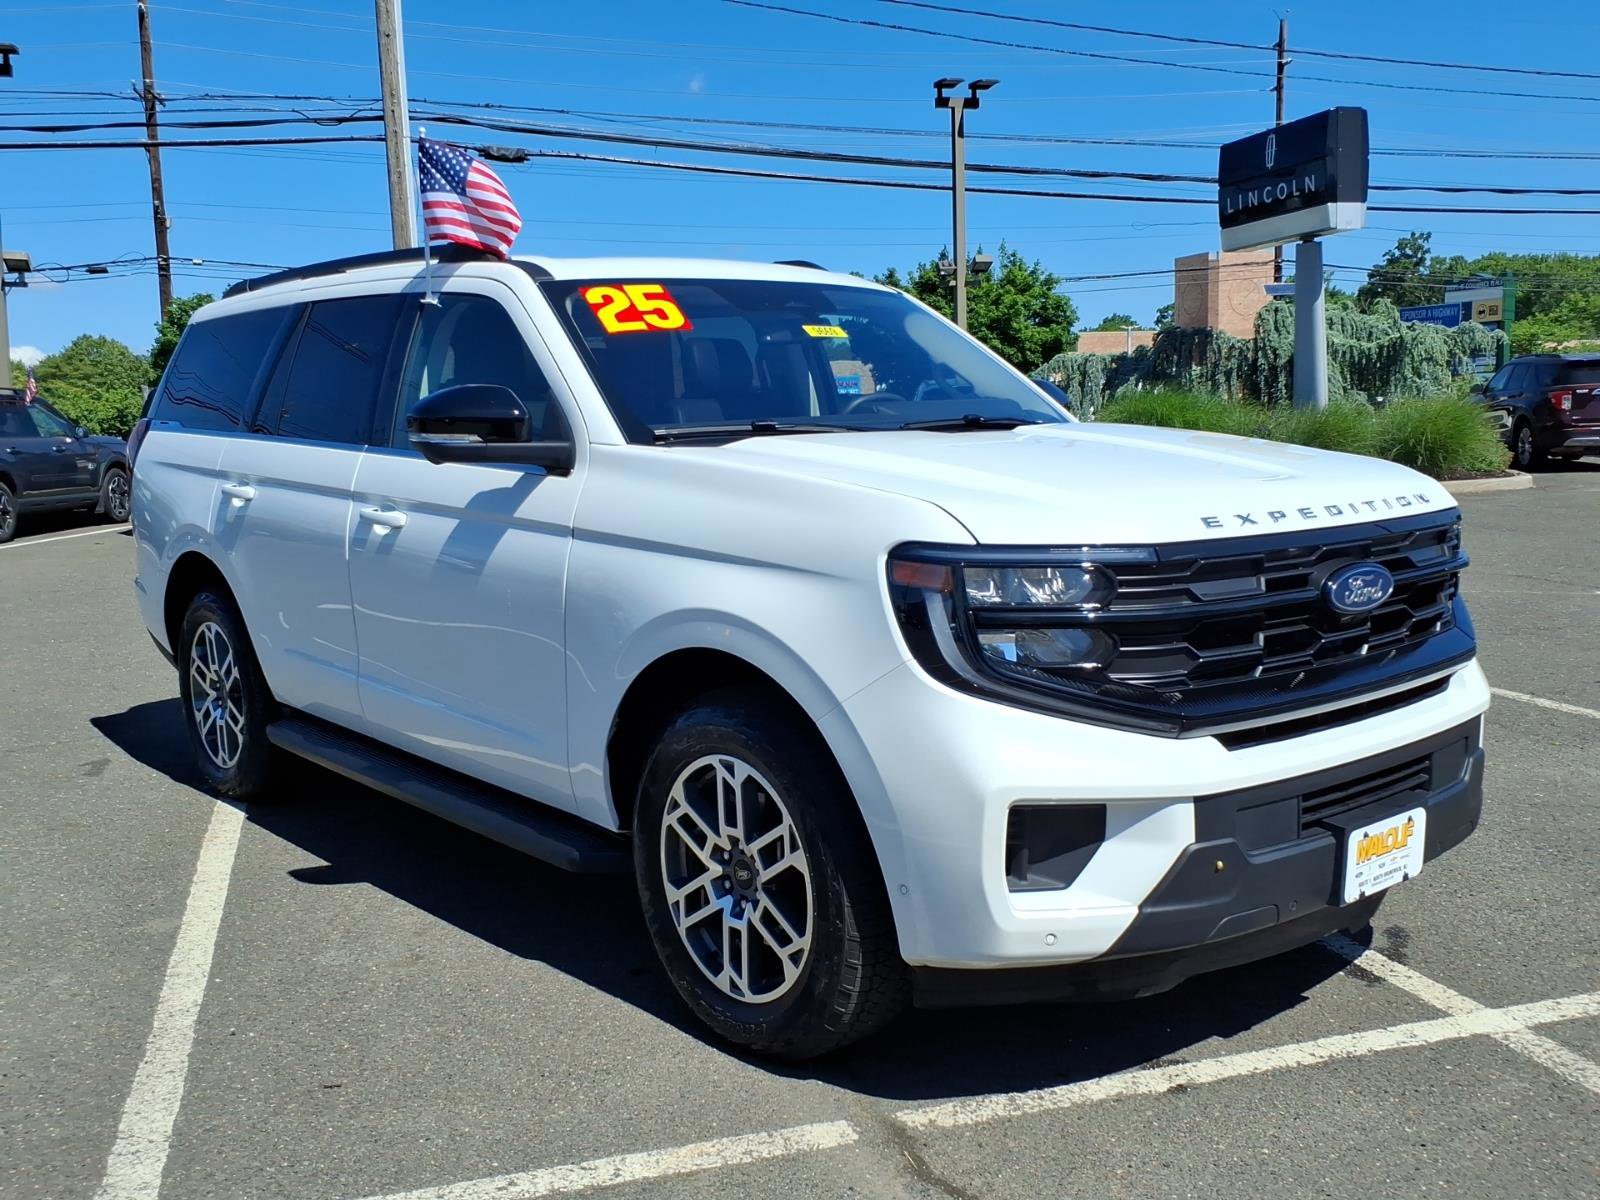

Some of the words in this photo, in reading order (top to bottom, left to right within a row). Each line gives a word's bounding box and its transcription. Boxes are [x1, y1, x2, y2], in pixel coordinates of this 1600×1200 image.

[1226, 174, 1316, 214] LINCOLN
[584, 284, 685, 334] 25
[1401, 309, 1427, 320] SPONSOR
[1200, 492, 1430, 529] EXPEDITION
[1344, 574, 1383, 605] Ford
[1355, 820, 1415, 865] MALOUF
